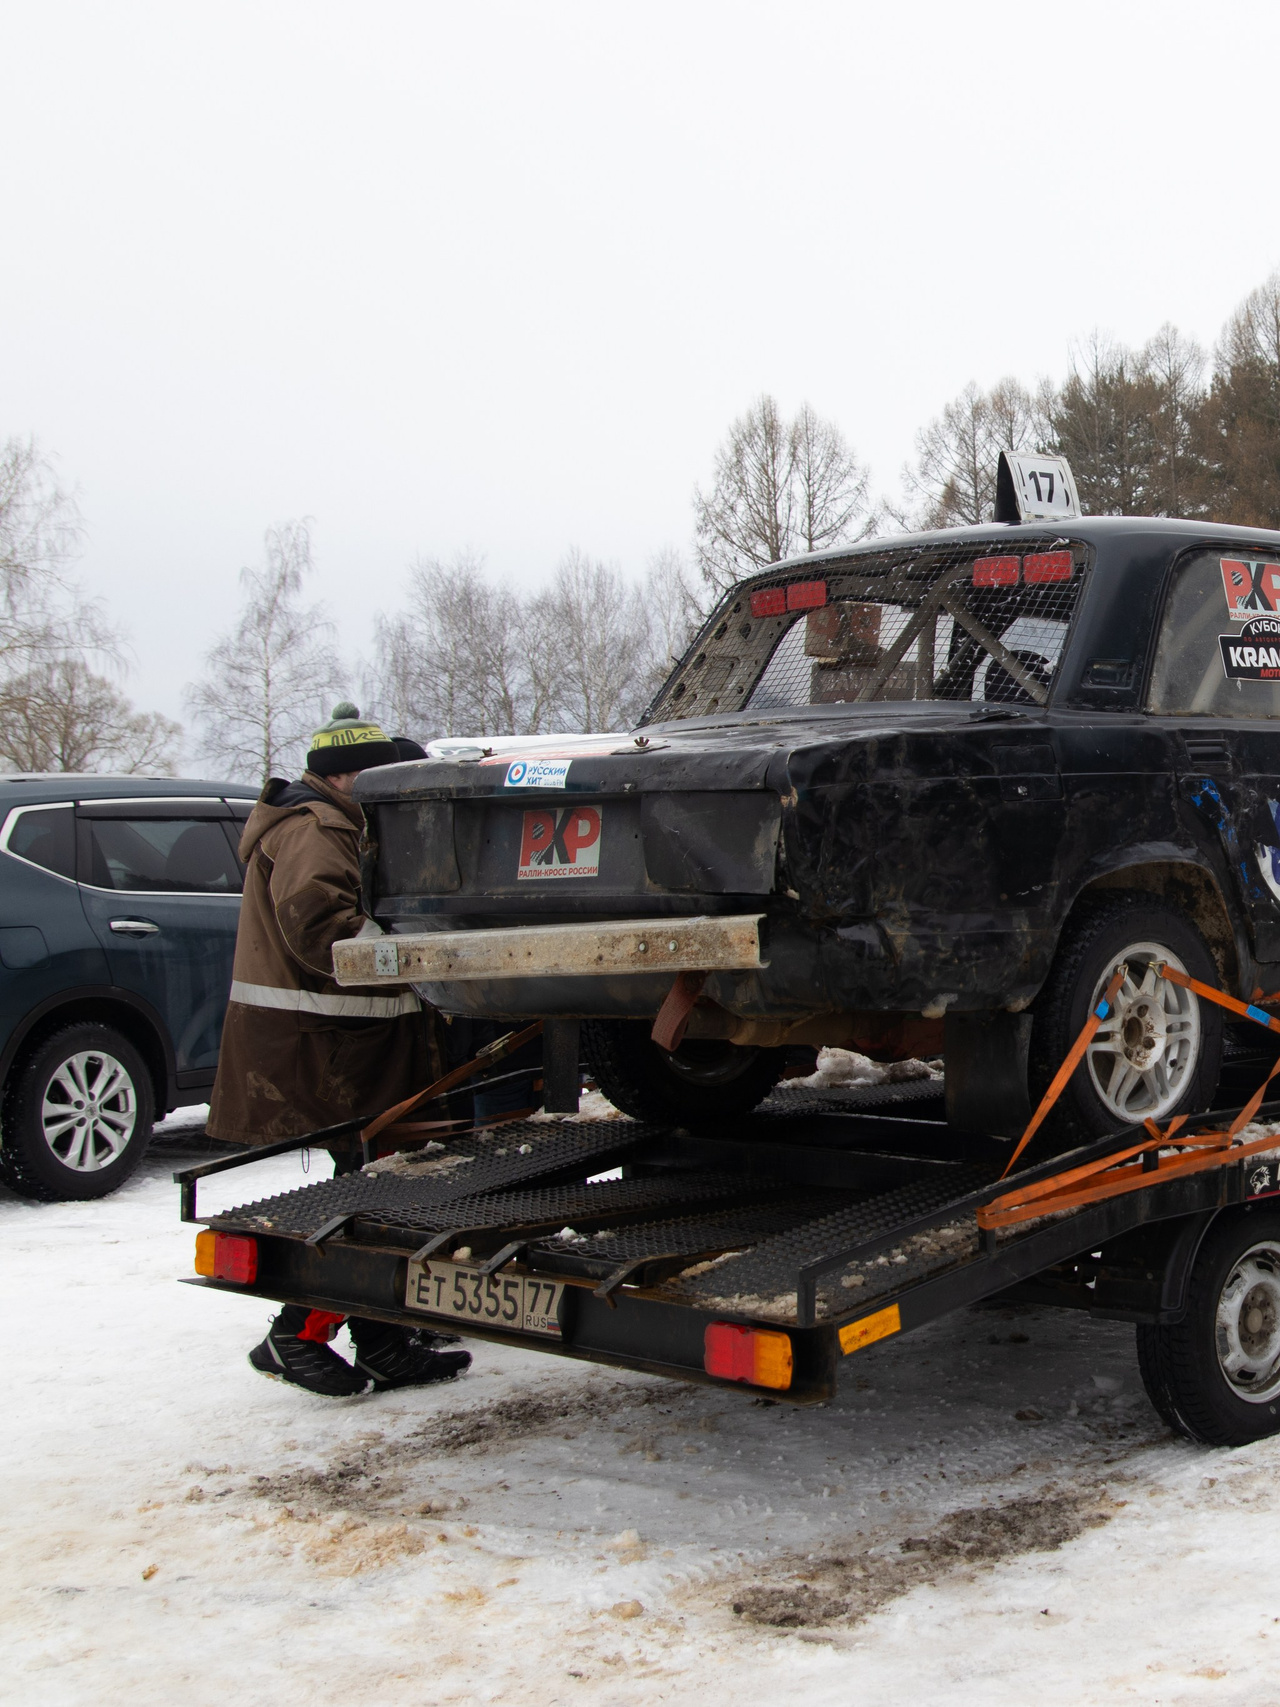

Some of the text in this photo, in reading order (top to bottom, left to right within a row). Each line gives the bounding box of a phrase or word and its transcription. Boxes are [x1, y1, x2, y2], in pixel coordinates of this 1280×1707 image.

[1028, 470, 1055, 504] 17
[527, 766, 566, 776] РУССКИЙ
[526, 777, 542, 786] ХИТ
[519, 866, 598, 878] РАЛЛИ-КРОСС РОССИИ
[452, 1271, 519, 1321] 5355
[528, 1281, 556, 1315] 77
[525, 1315, 547, 1329] RUS
